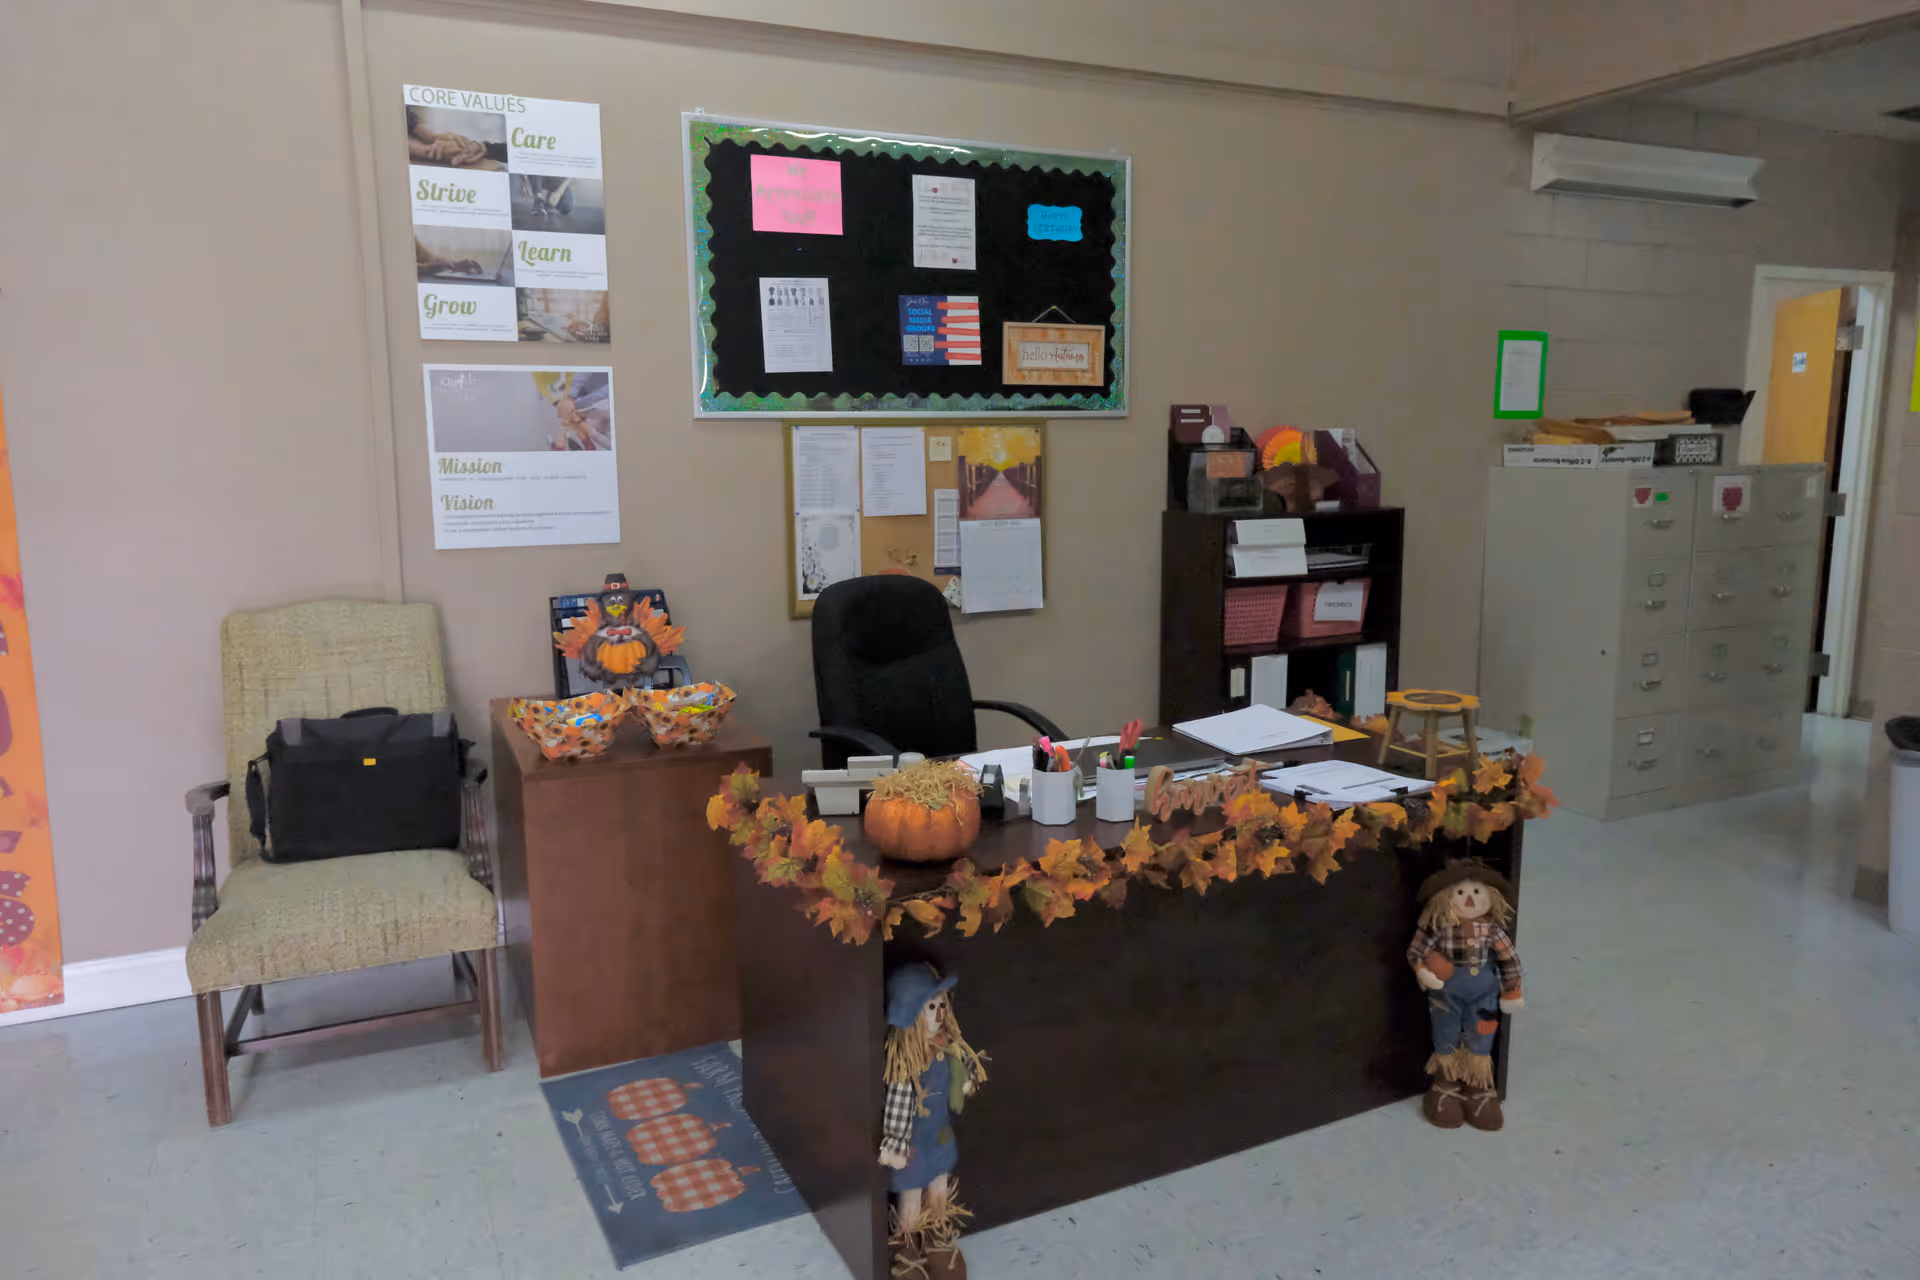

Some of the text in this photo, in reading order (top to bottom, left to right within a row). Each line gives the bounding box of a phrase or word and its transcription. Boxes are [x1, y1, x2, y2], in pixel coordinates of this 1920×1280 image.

[409, 86, 527, 114] CORE VALUES
[511, 127, 557, 151] Care
[416, 178, 477, 204] Strive
[518, 240, 572, 267] Learn
[423, 293, 478, 320] Grow
[907, 307, 933, 316] SOCIAL
[906, 324, 936, 333] GROUPS
[909, 316, 933, 324] MEDIA
[1022, 344, 1048, 361] hello
[438, 458, 503, 474] Mission
[440, 494, 495, 511] Vision
